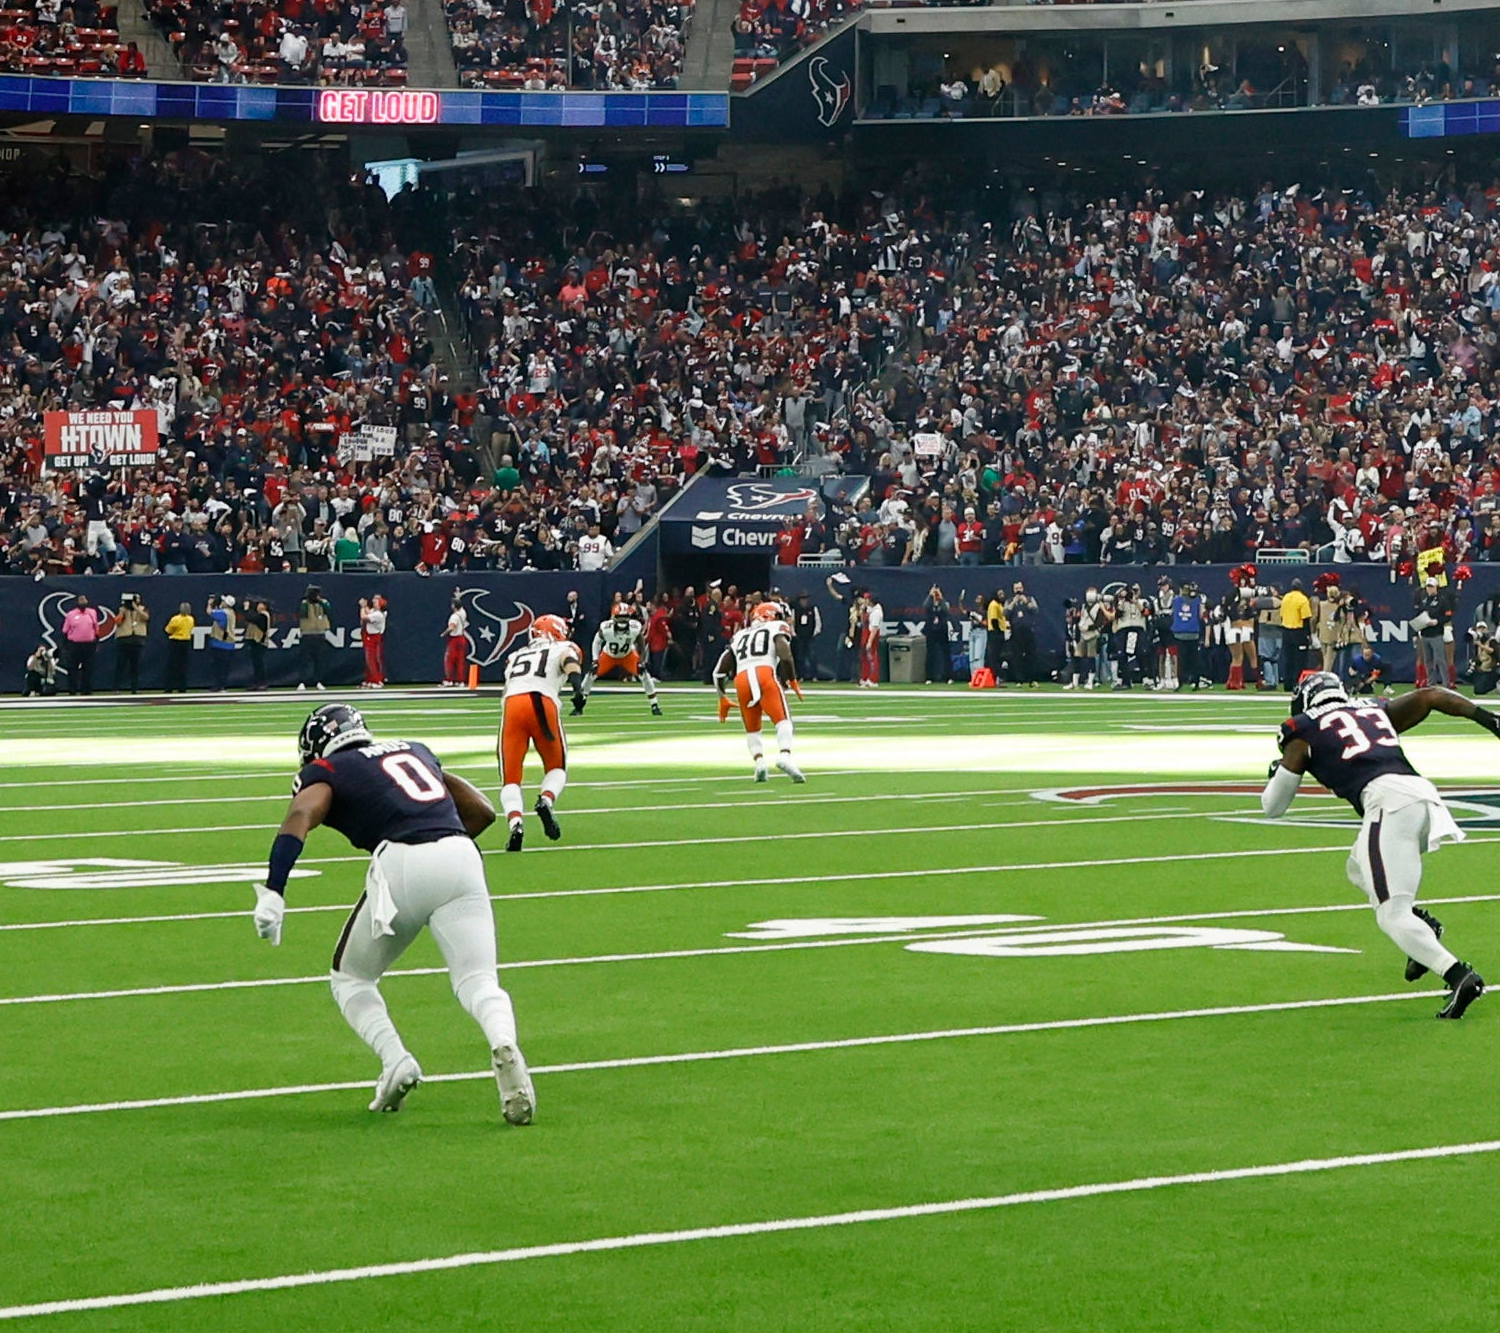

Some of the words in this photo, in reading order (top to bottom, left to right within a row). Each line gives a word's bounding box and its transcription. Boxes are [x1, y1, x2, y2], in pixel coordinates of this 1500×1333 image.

[320, 91, 371, 122] GET
[370, 92, 437, 123] LOUD
[69, 413, 84, 424] WE
[86, 413, 112, 424] NEED
[114, 412, 134, 424] YOU
[60, 424, 142, 452] HTOWN
[54, 455, 72, 467] GET
[73, 455, 89, 467] UP!
[109, 454, 127, 466] GET
[129, 453, 156, 465] LOUD!
[388, 508, 402, 523] 80
[435, 537, 442, 550] 7
[451, 538, 466, 552] 80
[722, 528, 777, 547] Chevr
[584, 543, 600, 553] 99
[608, 642, 630, 654] 94
[736, 629, 770, 660] 40
[510, 649, 550, 678] 51
[1319, 708, 1401, 760] 33
[380, 753, 446, 803] 0
